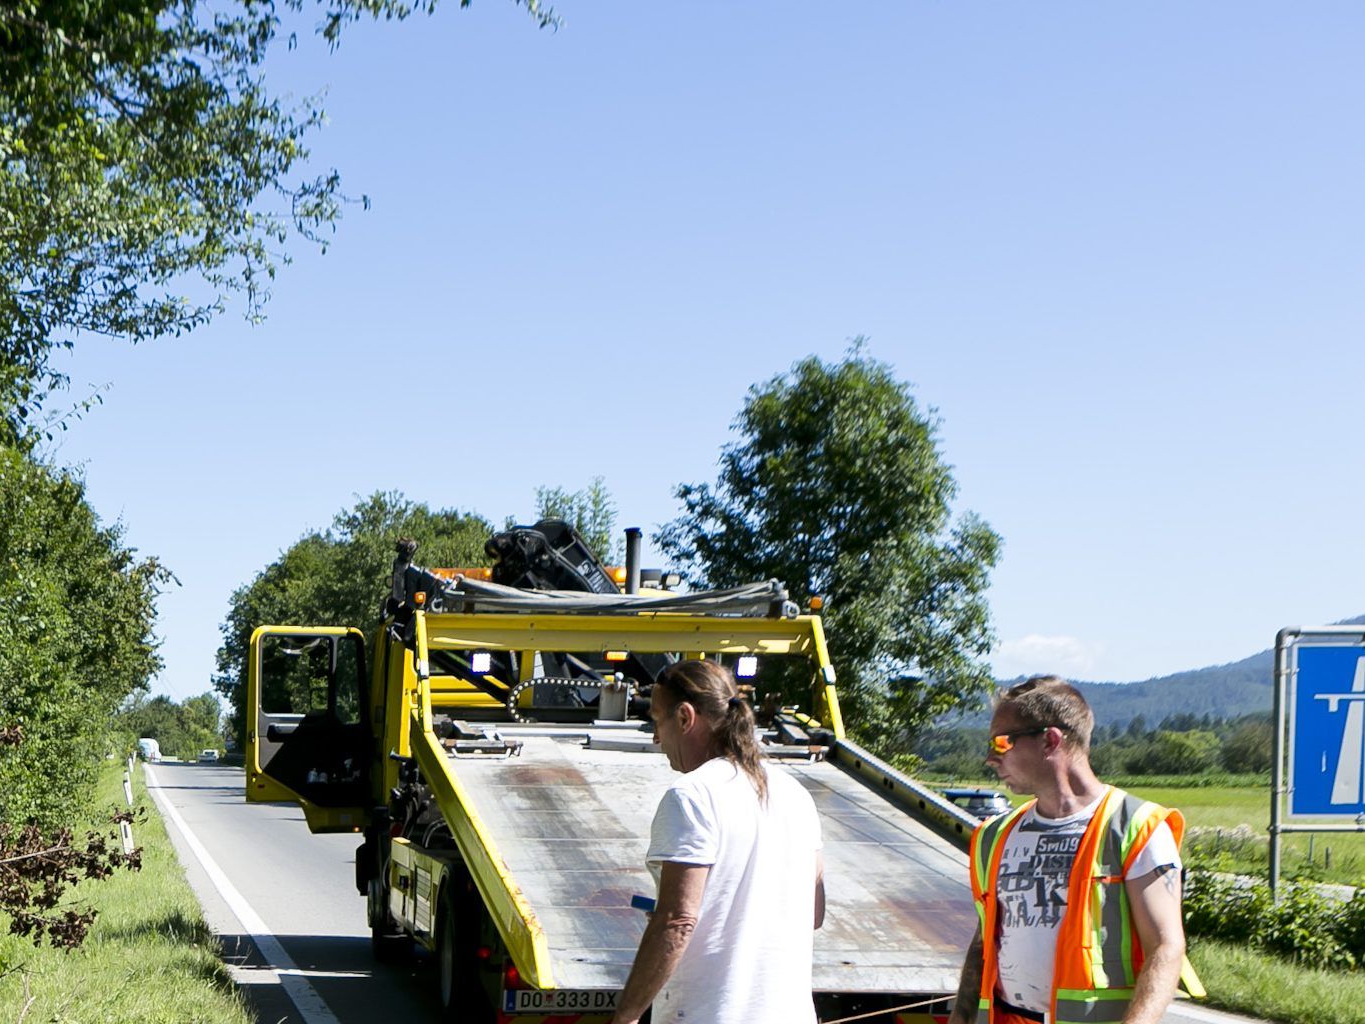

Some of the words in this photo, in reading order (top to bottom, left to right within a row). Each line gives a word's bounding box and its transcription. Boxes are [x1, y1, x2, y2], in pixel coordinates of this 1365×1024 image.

[521, 992, 542, 1008] DO
[556, 992, 590, 1008] 333
[594, 992, 616, 1008] DX
